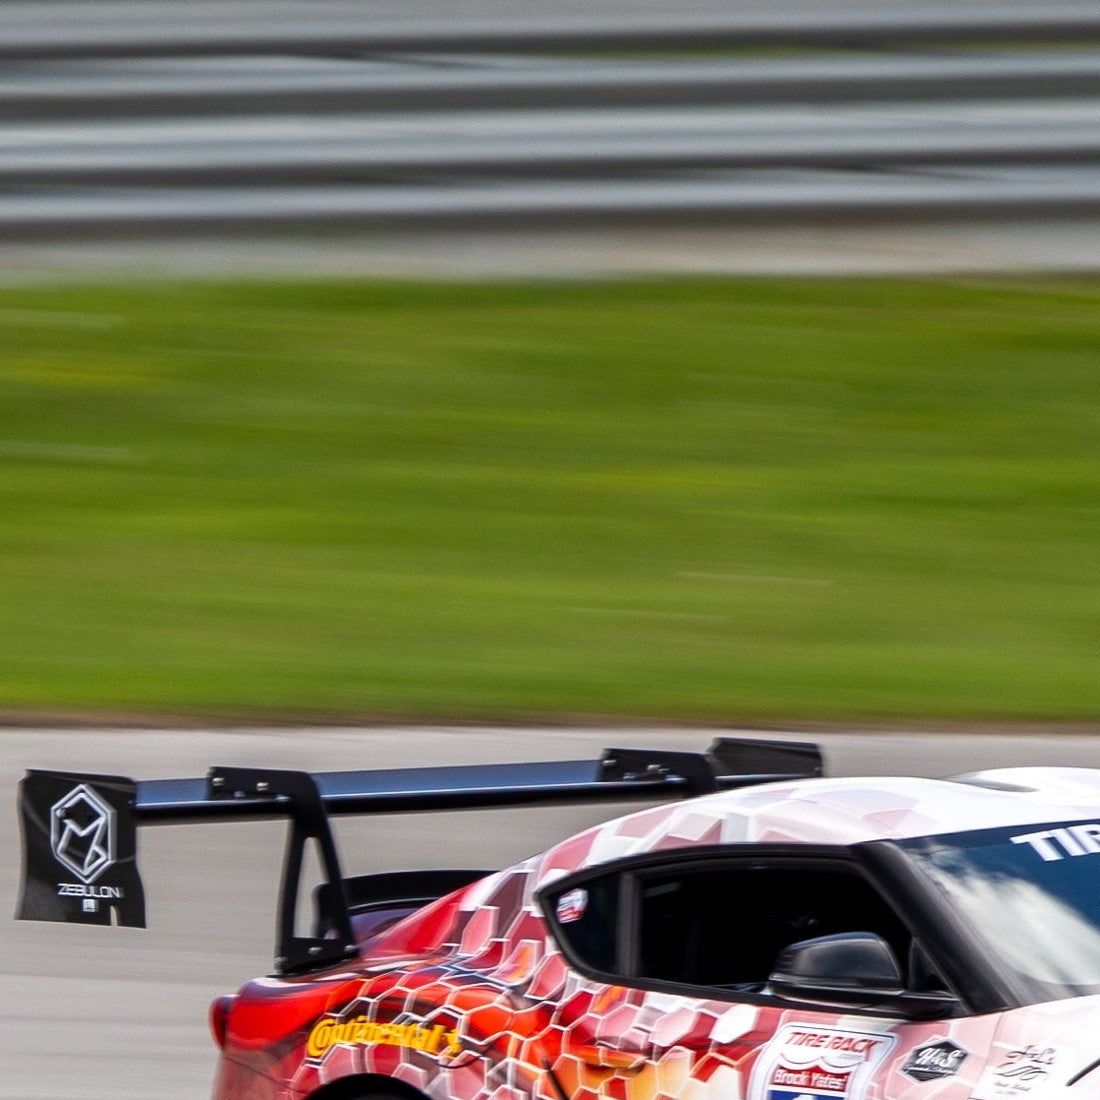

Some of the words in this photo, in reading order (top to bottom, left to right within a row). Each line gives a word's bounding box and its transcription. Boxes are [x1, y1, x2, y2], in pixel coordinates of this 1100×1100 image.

[57, 883, 124, 898] ZEBULON
[307, 1015, 447, 1057] Continental
[785, 1032, 826, 1048] TIRE
[826, 1036, 883, 1062] RACK
[774, 1069, 809, 1086] Brock
